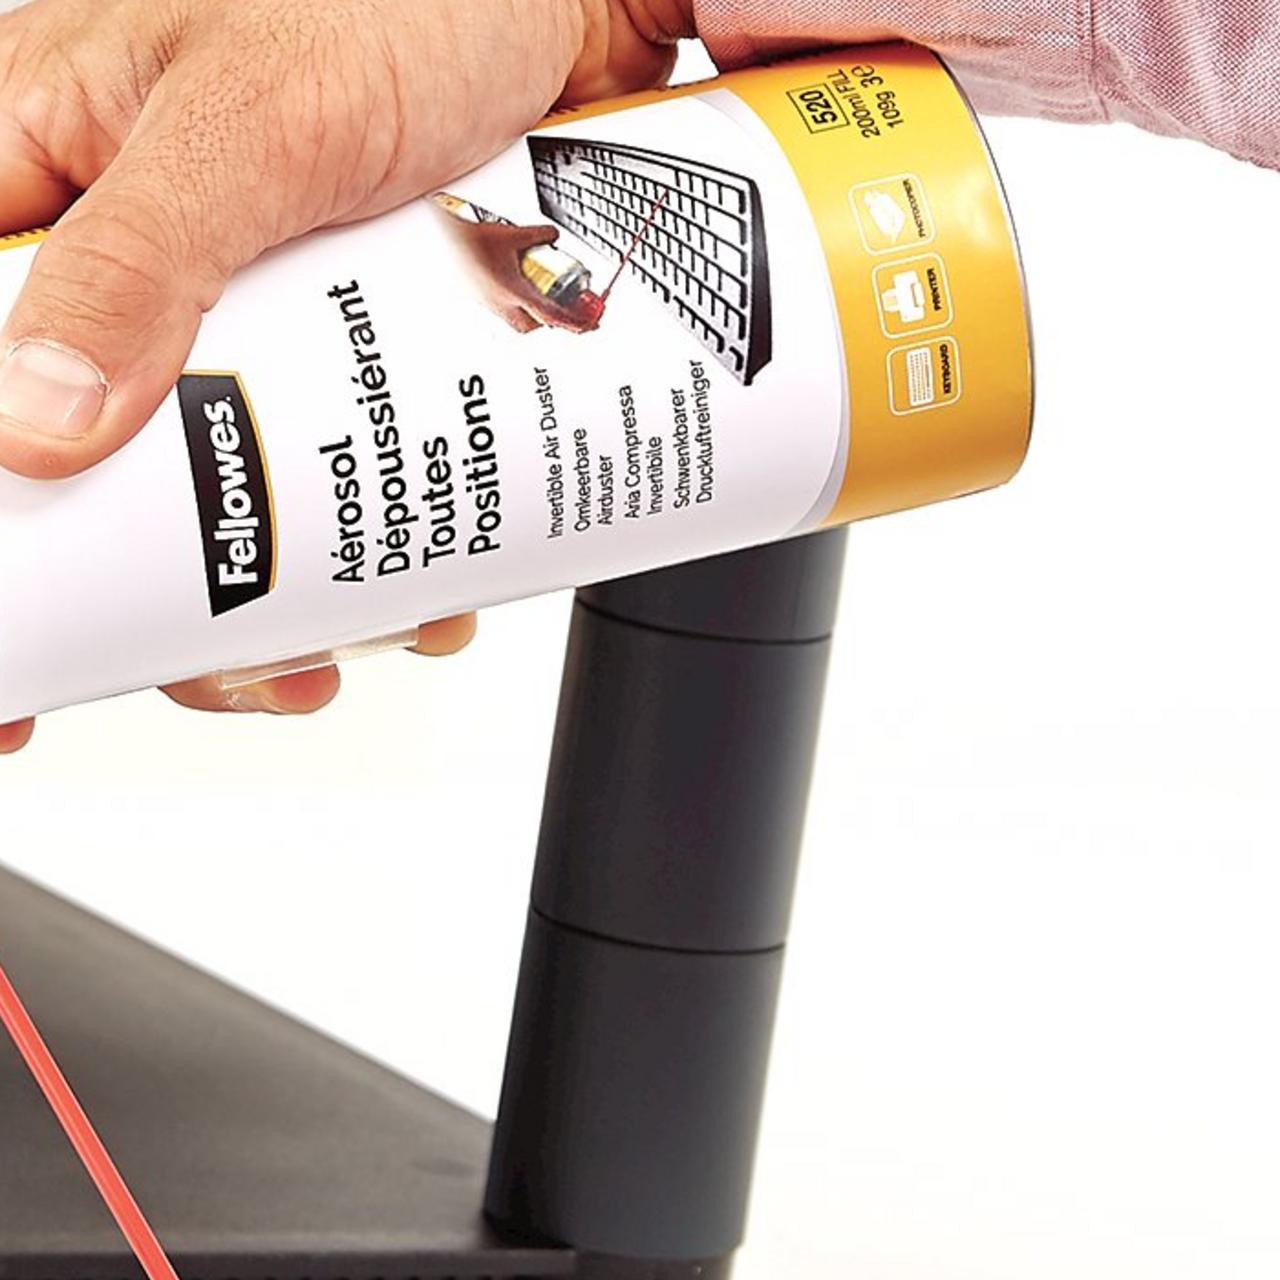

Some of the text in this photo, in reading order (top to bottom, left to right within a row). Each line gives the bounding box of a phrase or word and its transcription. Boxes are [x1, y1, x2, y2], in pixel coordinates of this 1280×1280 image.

[798, 89, 838, 126] 520
[843, 92, 881, 138] 200ml
[876, 90, 904, 128] 109g
[926, 267, 941, 311] PRINTER
[327, 279, 419, 576] Dépoussiérant
[939, 343, 951, 394] KEYBOARD
[202, 399, 259, 586] Fellowes
[458, 373, 502, 556] Positions
[534, 367, 564, 539] Invertible Air Duster
[573, 427, 591, 532] Omkeerbare
[597, 455, 614, 526] Airduster
[619, 385, 643, 519] Aria Compressa
[646, 436, 664, 515] Invertibile
[670, 388, 691, 510] Schwenkbarer
[689, 359, 714, 504] Druckluftreiniger
[318, 434, 365, 582] Aérosol
[421, 436, 457, 568] Toutes
